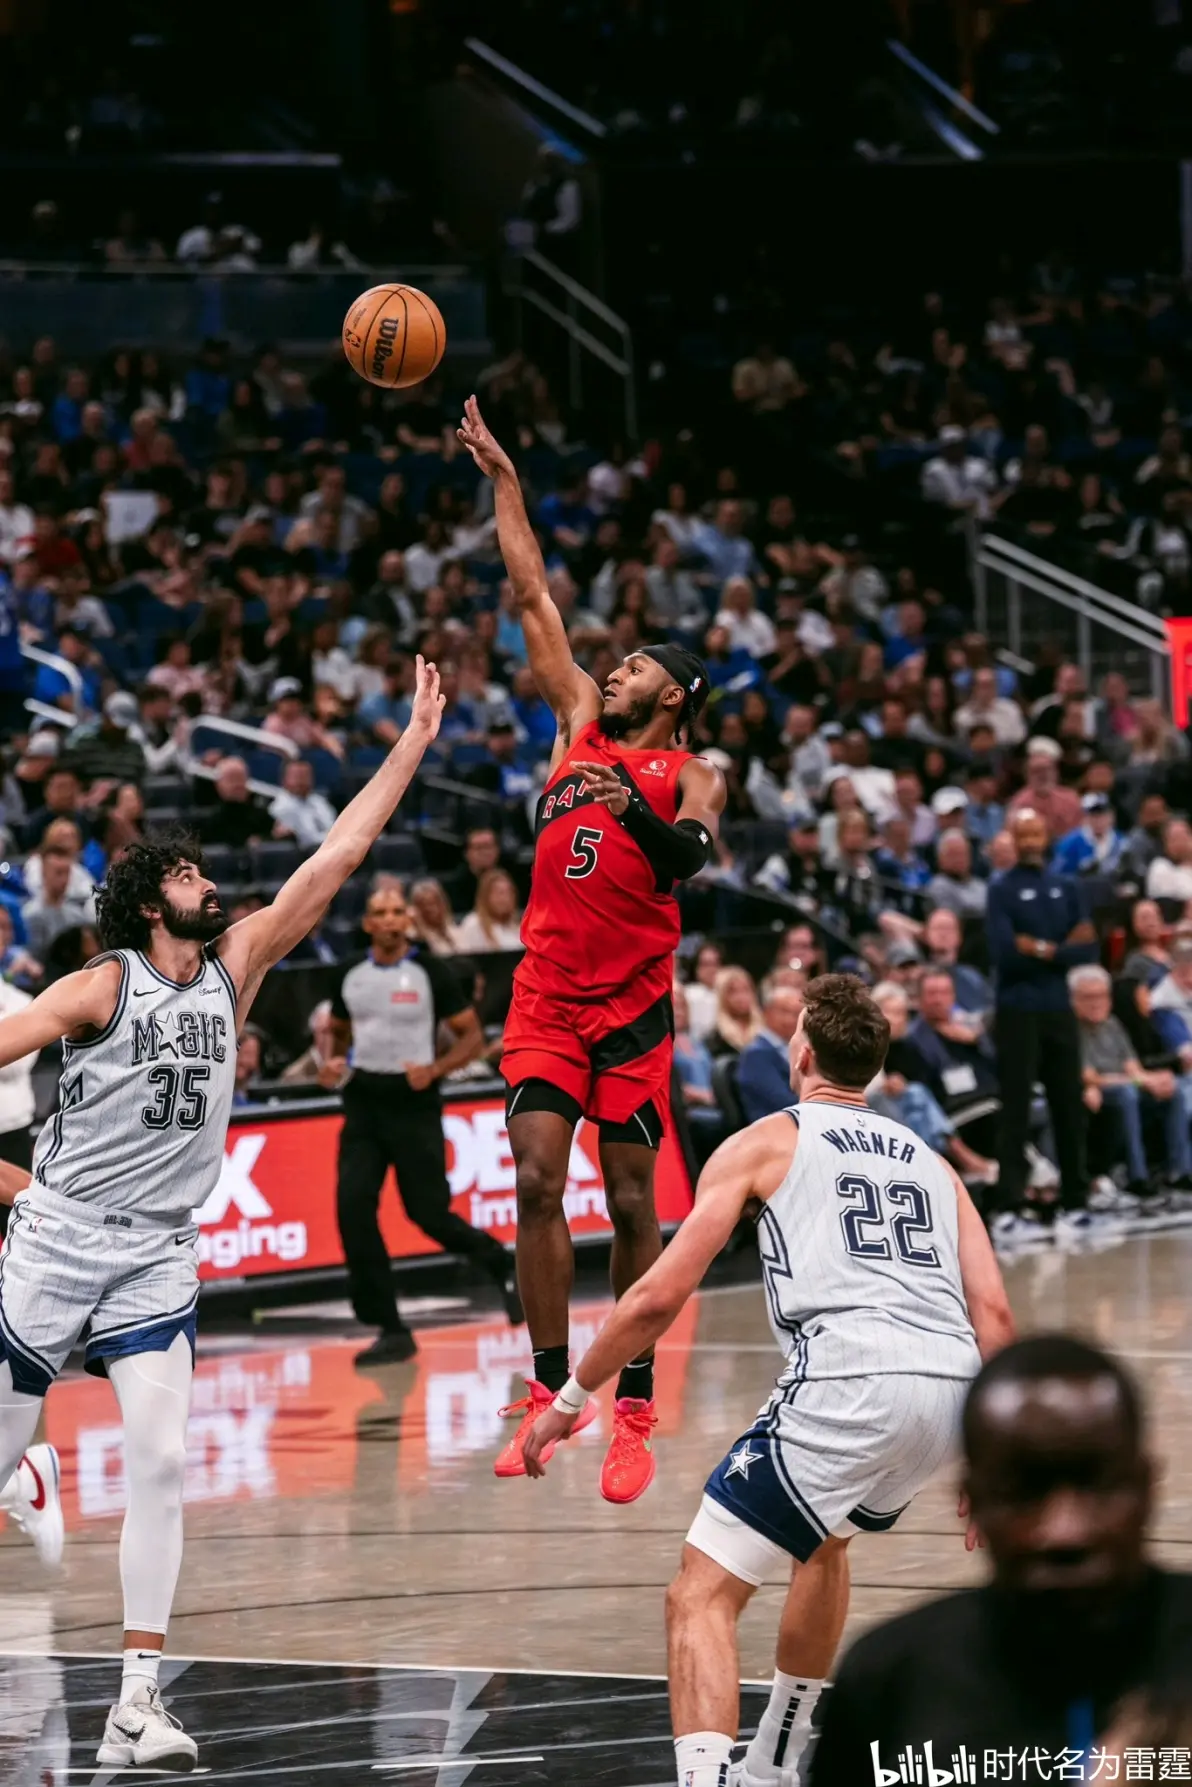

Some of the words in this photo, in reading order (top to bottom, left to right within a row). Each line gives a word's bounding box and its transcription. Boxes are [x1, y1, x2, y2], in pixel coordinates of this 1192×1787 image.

[372, 317, 399, 379] Wilson
[564, 825, 604, 879] 5
[141, 1065, 211, 1131] 35
[820, 1127, 916, 1164] WAGNER
[835, 1172, 942, 1269] 22
